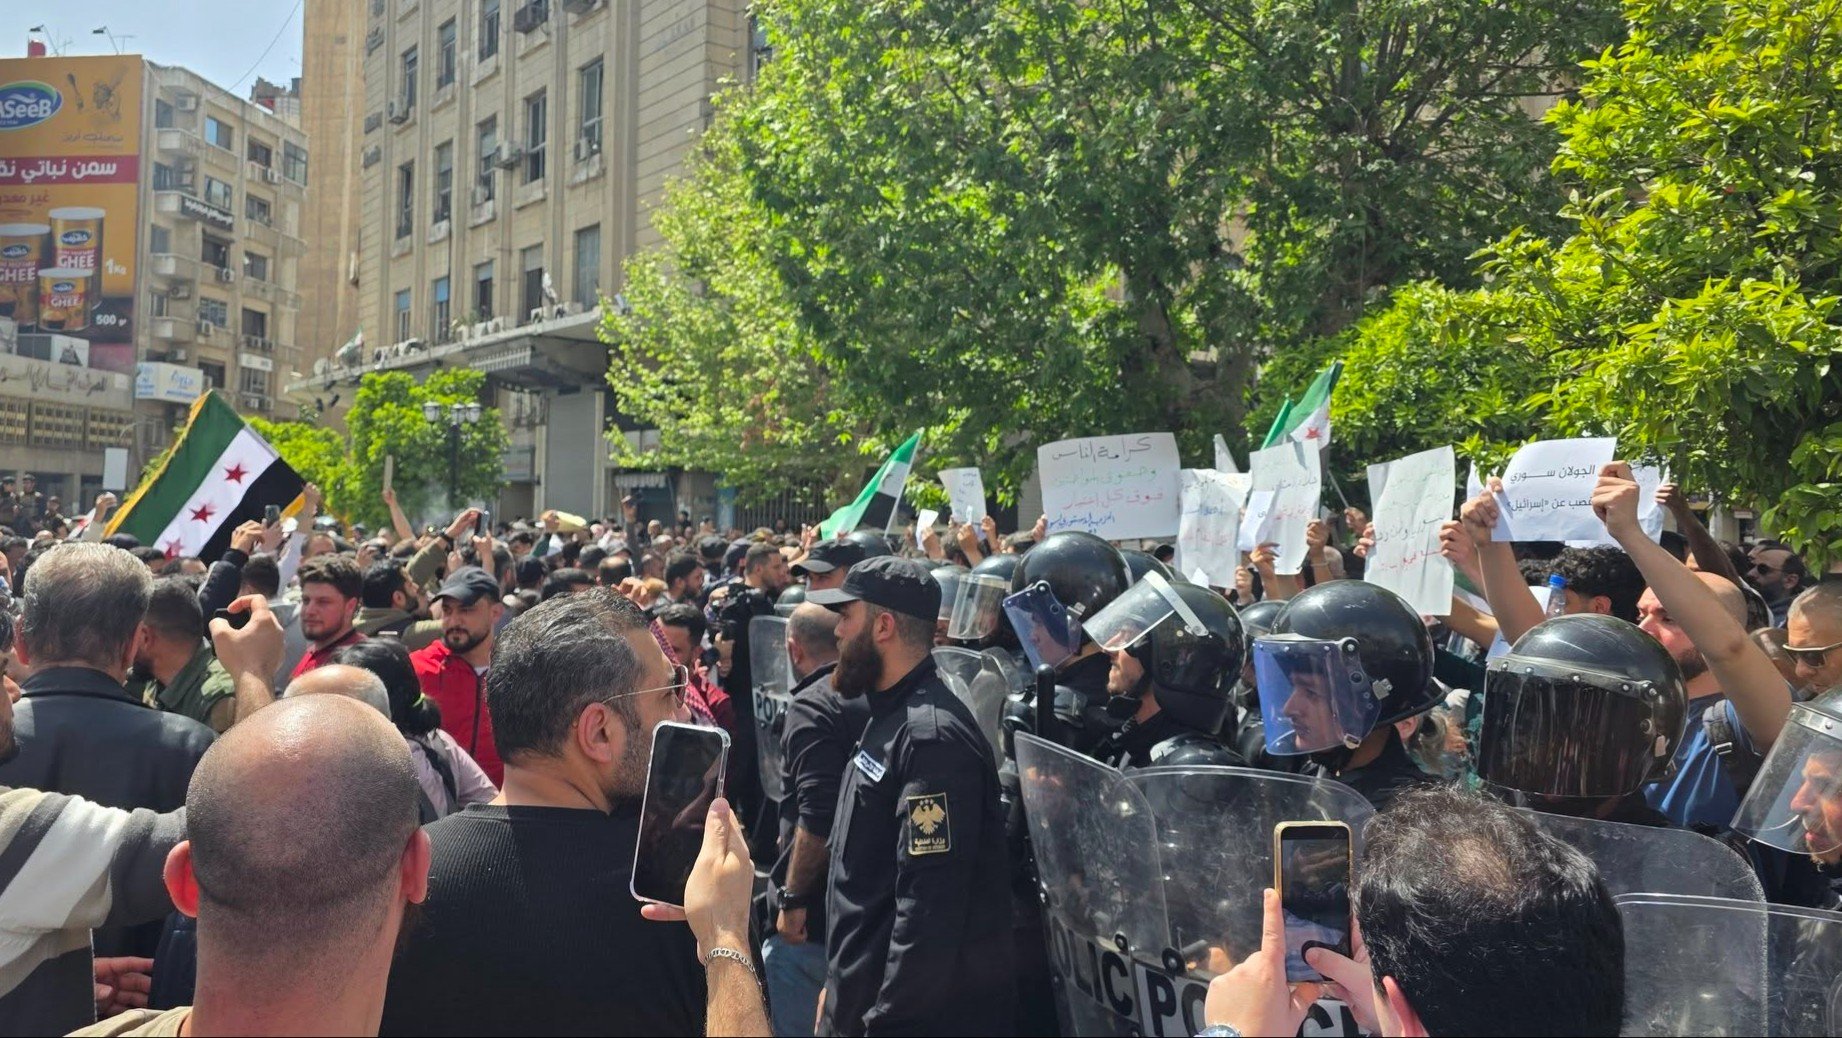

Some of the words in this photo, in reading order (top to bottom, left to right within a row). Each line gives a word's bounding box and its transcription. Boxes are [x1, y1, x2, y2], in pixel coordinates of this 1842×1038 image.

[0, 159, 16, 178] نق
[21, 159, 68, 184] نباتي
[71, 161, 117, 179] سمن
[59, 254, 95, 268] GHEE
[51, 298, 79, 307] GHEE
[96, 315, 117, 325] 500
[1097, 436, 1152, 462] كرامة
[1559, 465, 1596, 479] الجولان
[1126, 489, 1163, 505] فوق
[1551, 498, 1565, 509] عن
